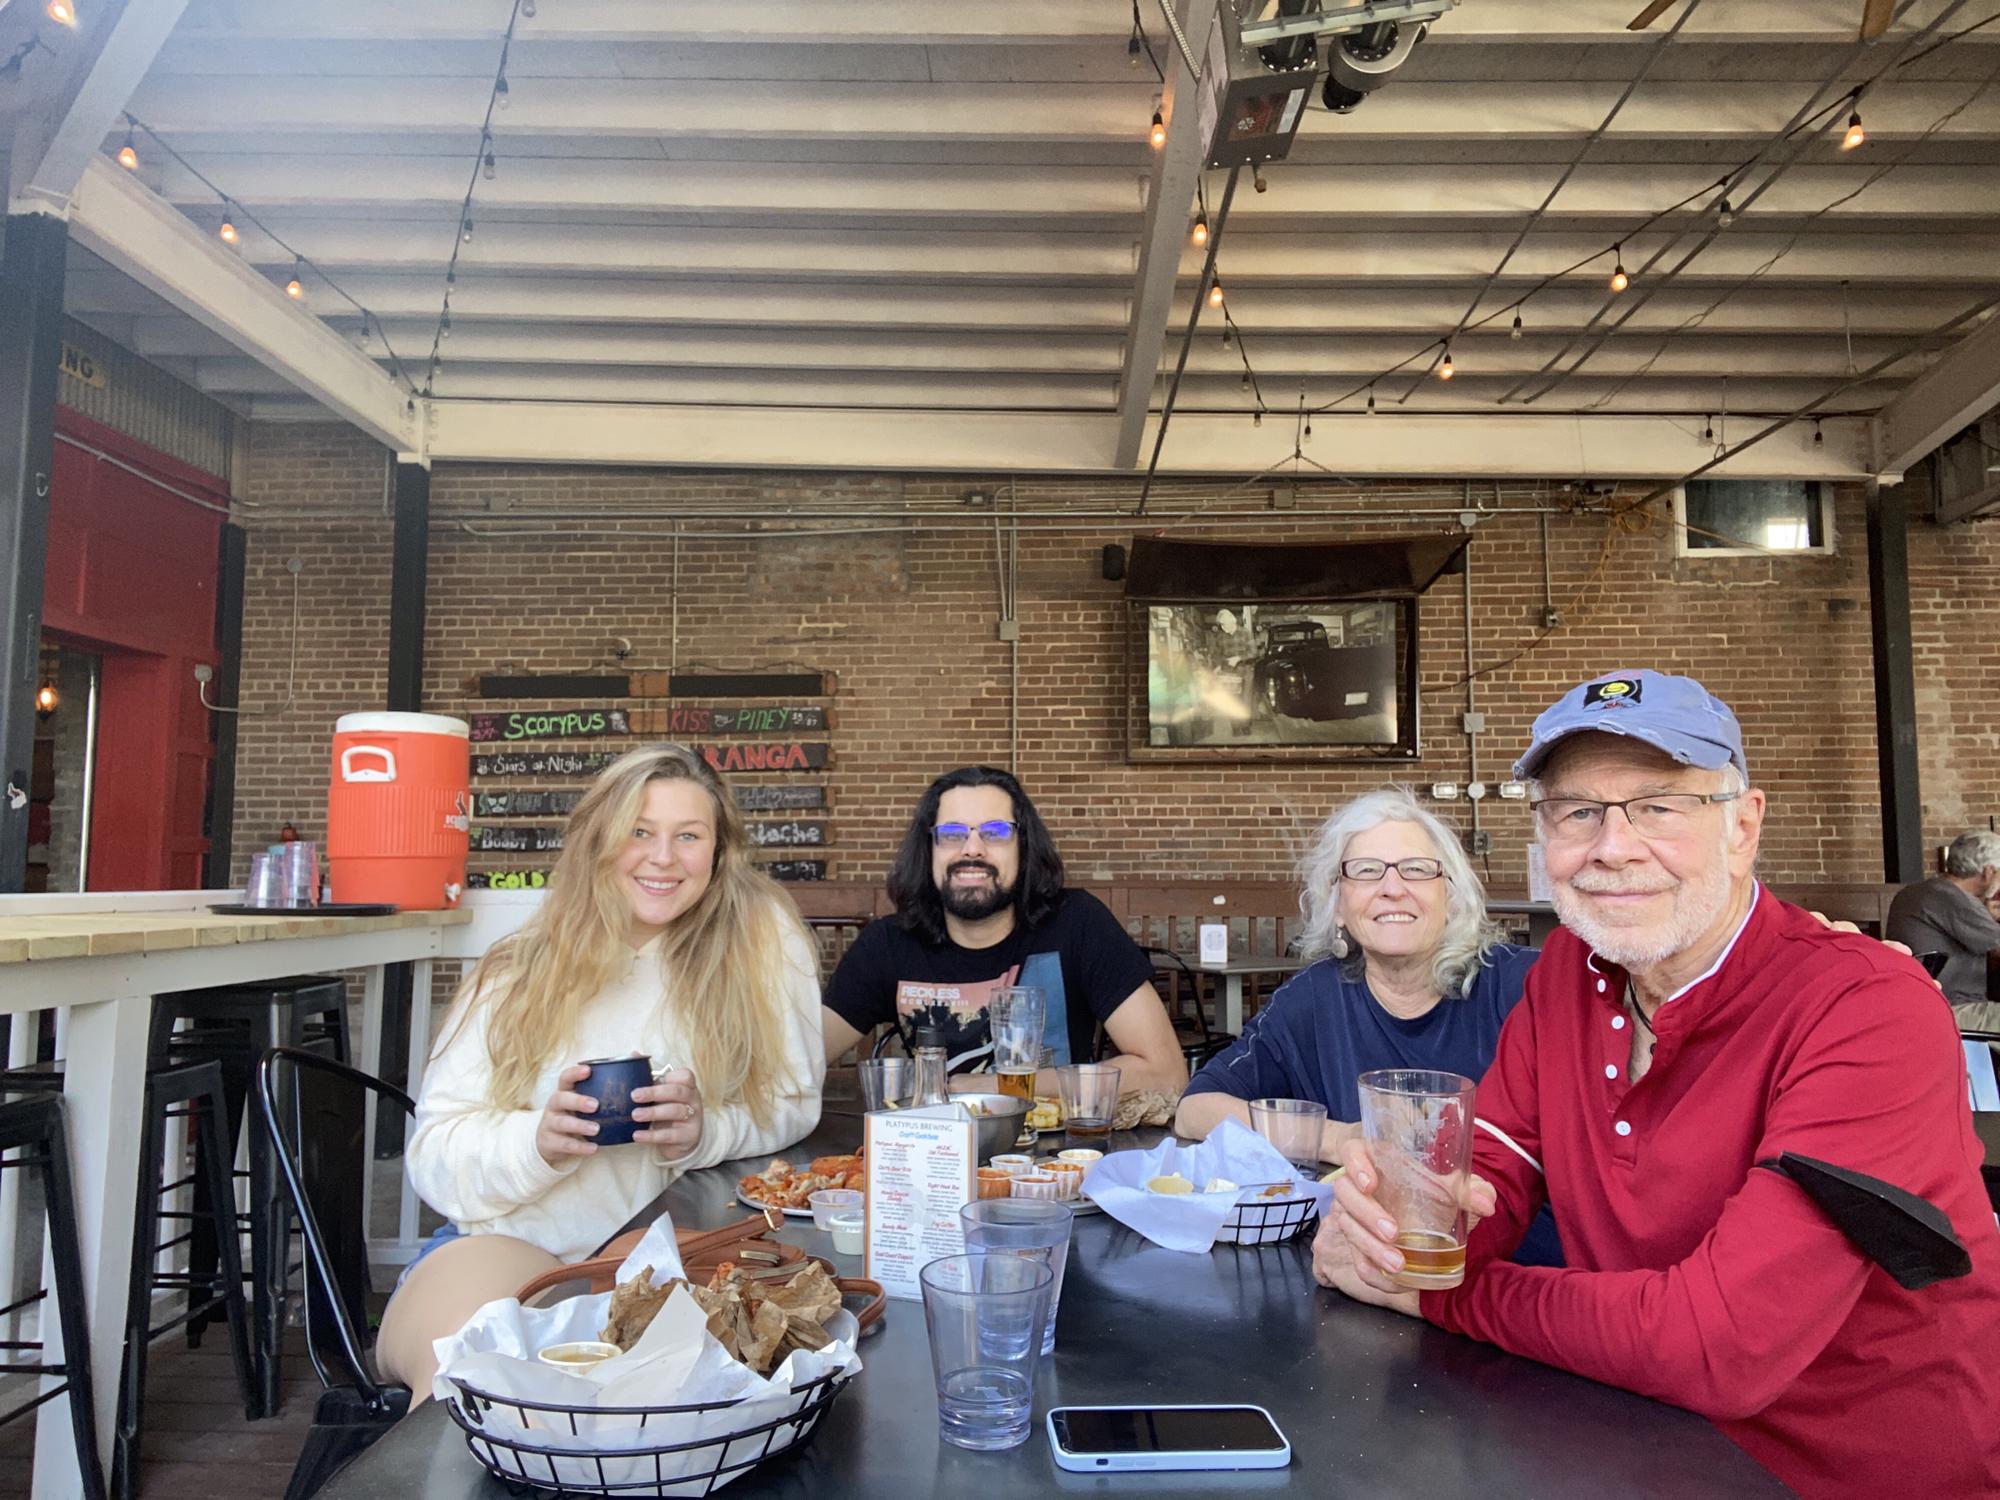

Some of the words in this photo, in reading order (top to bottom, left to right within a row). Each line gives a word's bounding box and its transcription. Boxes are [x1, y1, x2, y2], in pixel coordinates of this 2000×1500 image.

[670, 710, 710, 732] KISS
[548, 756, 583, 774] Night
[901, 986, 961, 1000] RECKLESS
[886, 1120, 918, 1129] PLATYPUS
[920, 1123, 953, 1132] BREWING
